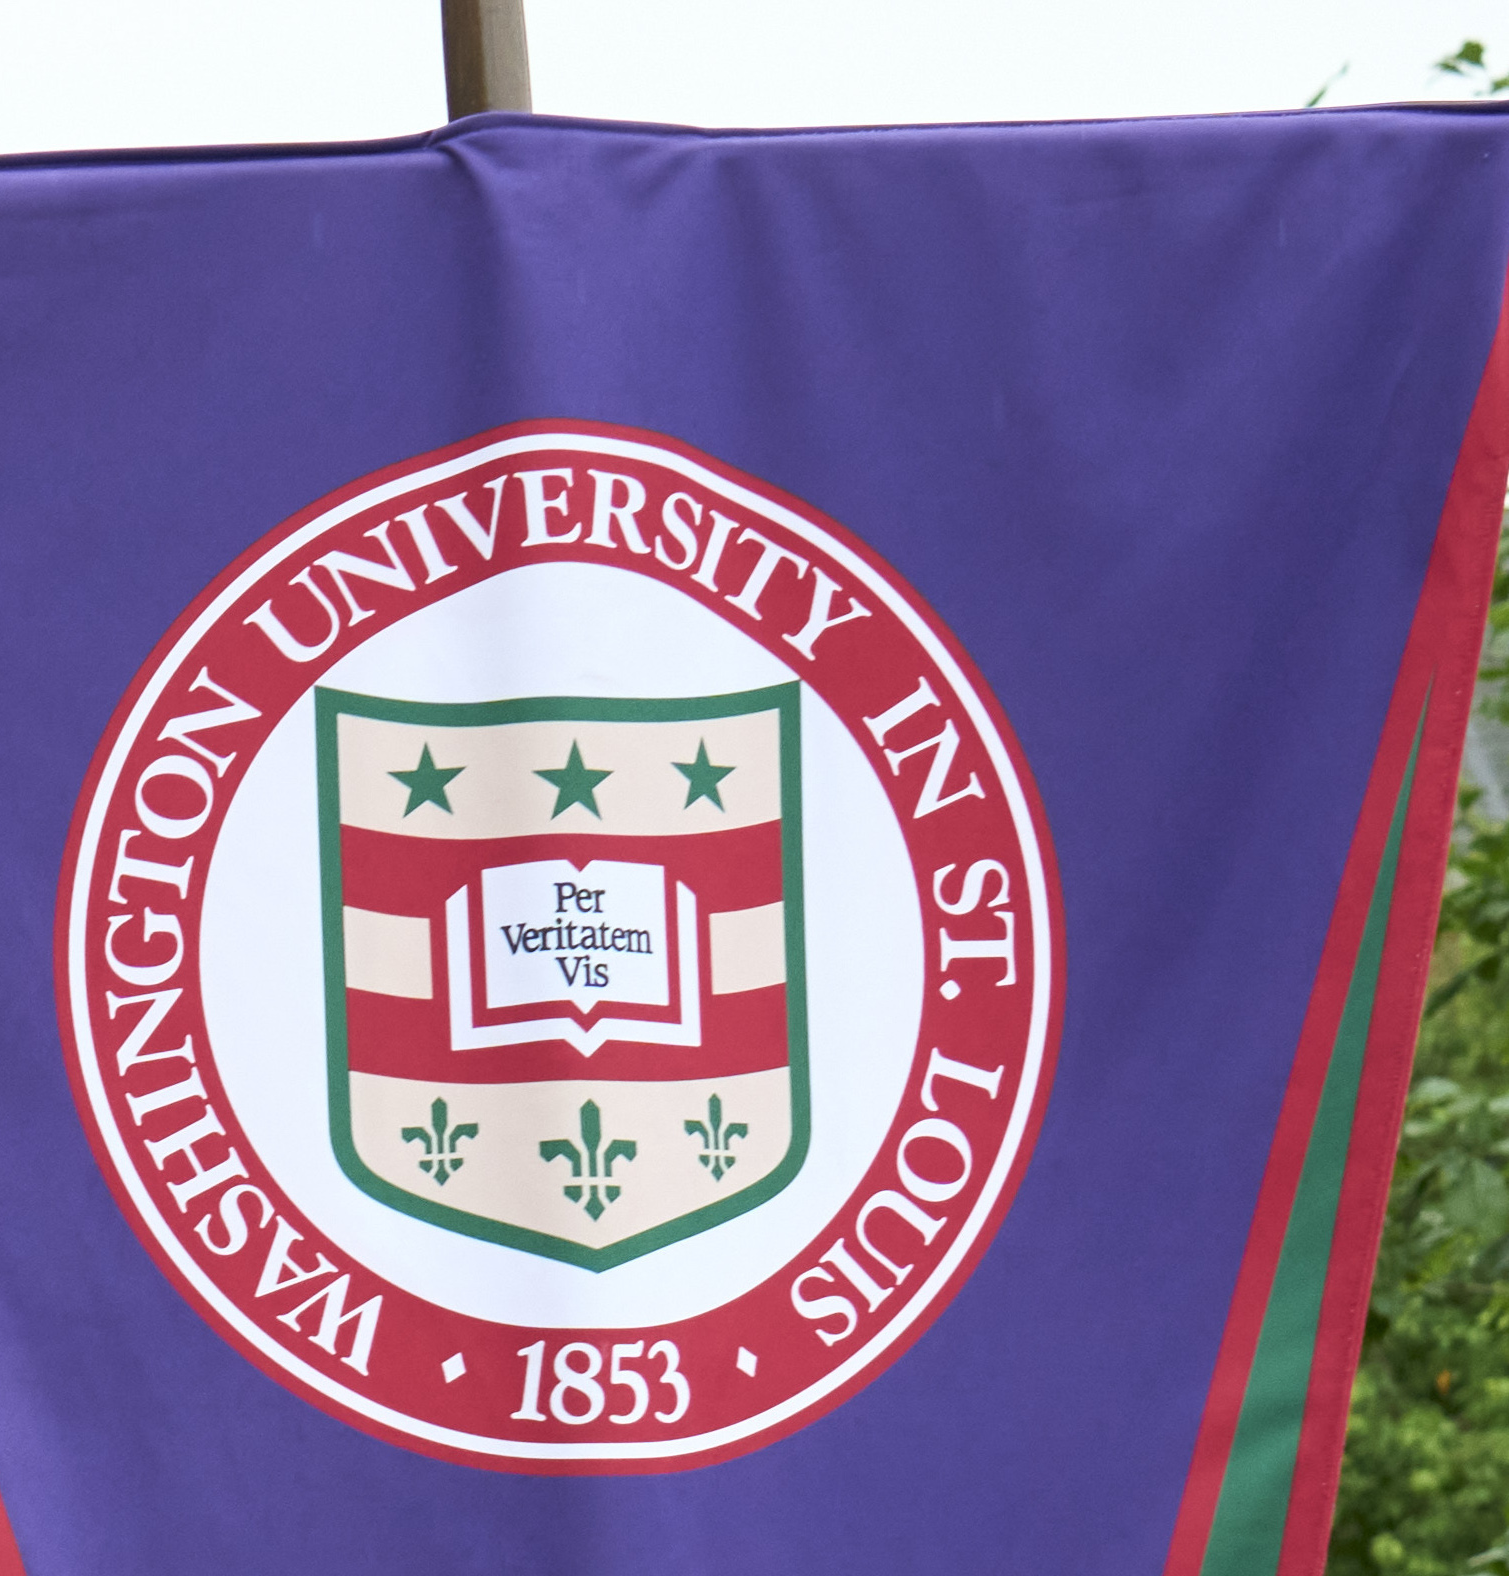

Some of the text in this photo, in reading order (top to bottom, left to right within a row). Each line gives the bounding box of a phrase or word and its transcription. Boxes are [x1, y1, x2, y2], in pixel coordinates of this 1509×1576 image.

[553, 881, 606, 914] Per
[103, 467, 1016, 1378] WASHINGTON UNIVERSITY IN ST. LOUIS
[500, 917, 653, 955] Veritatem
[555, 954, 610, 988] Vis
[510, 1339, 691, 1425] 1853
